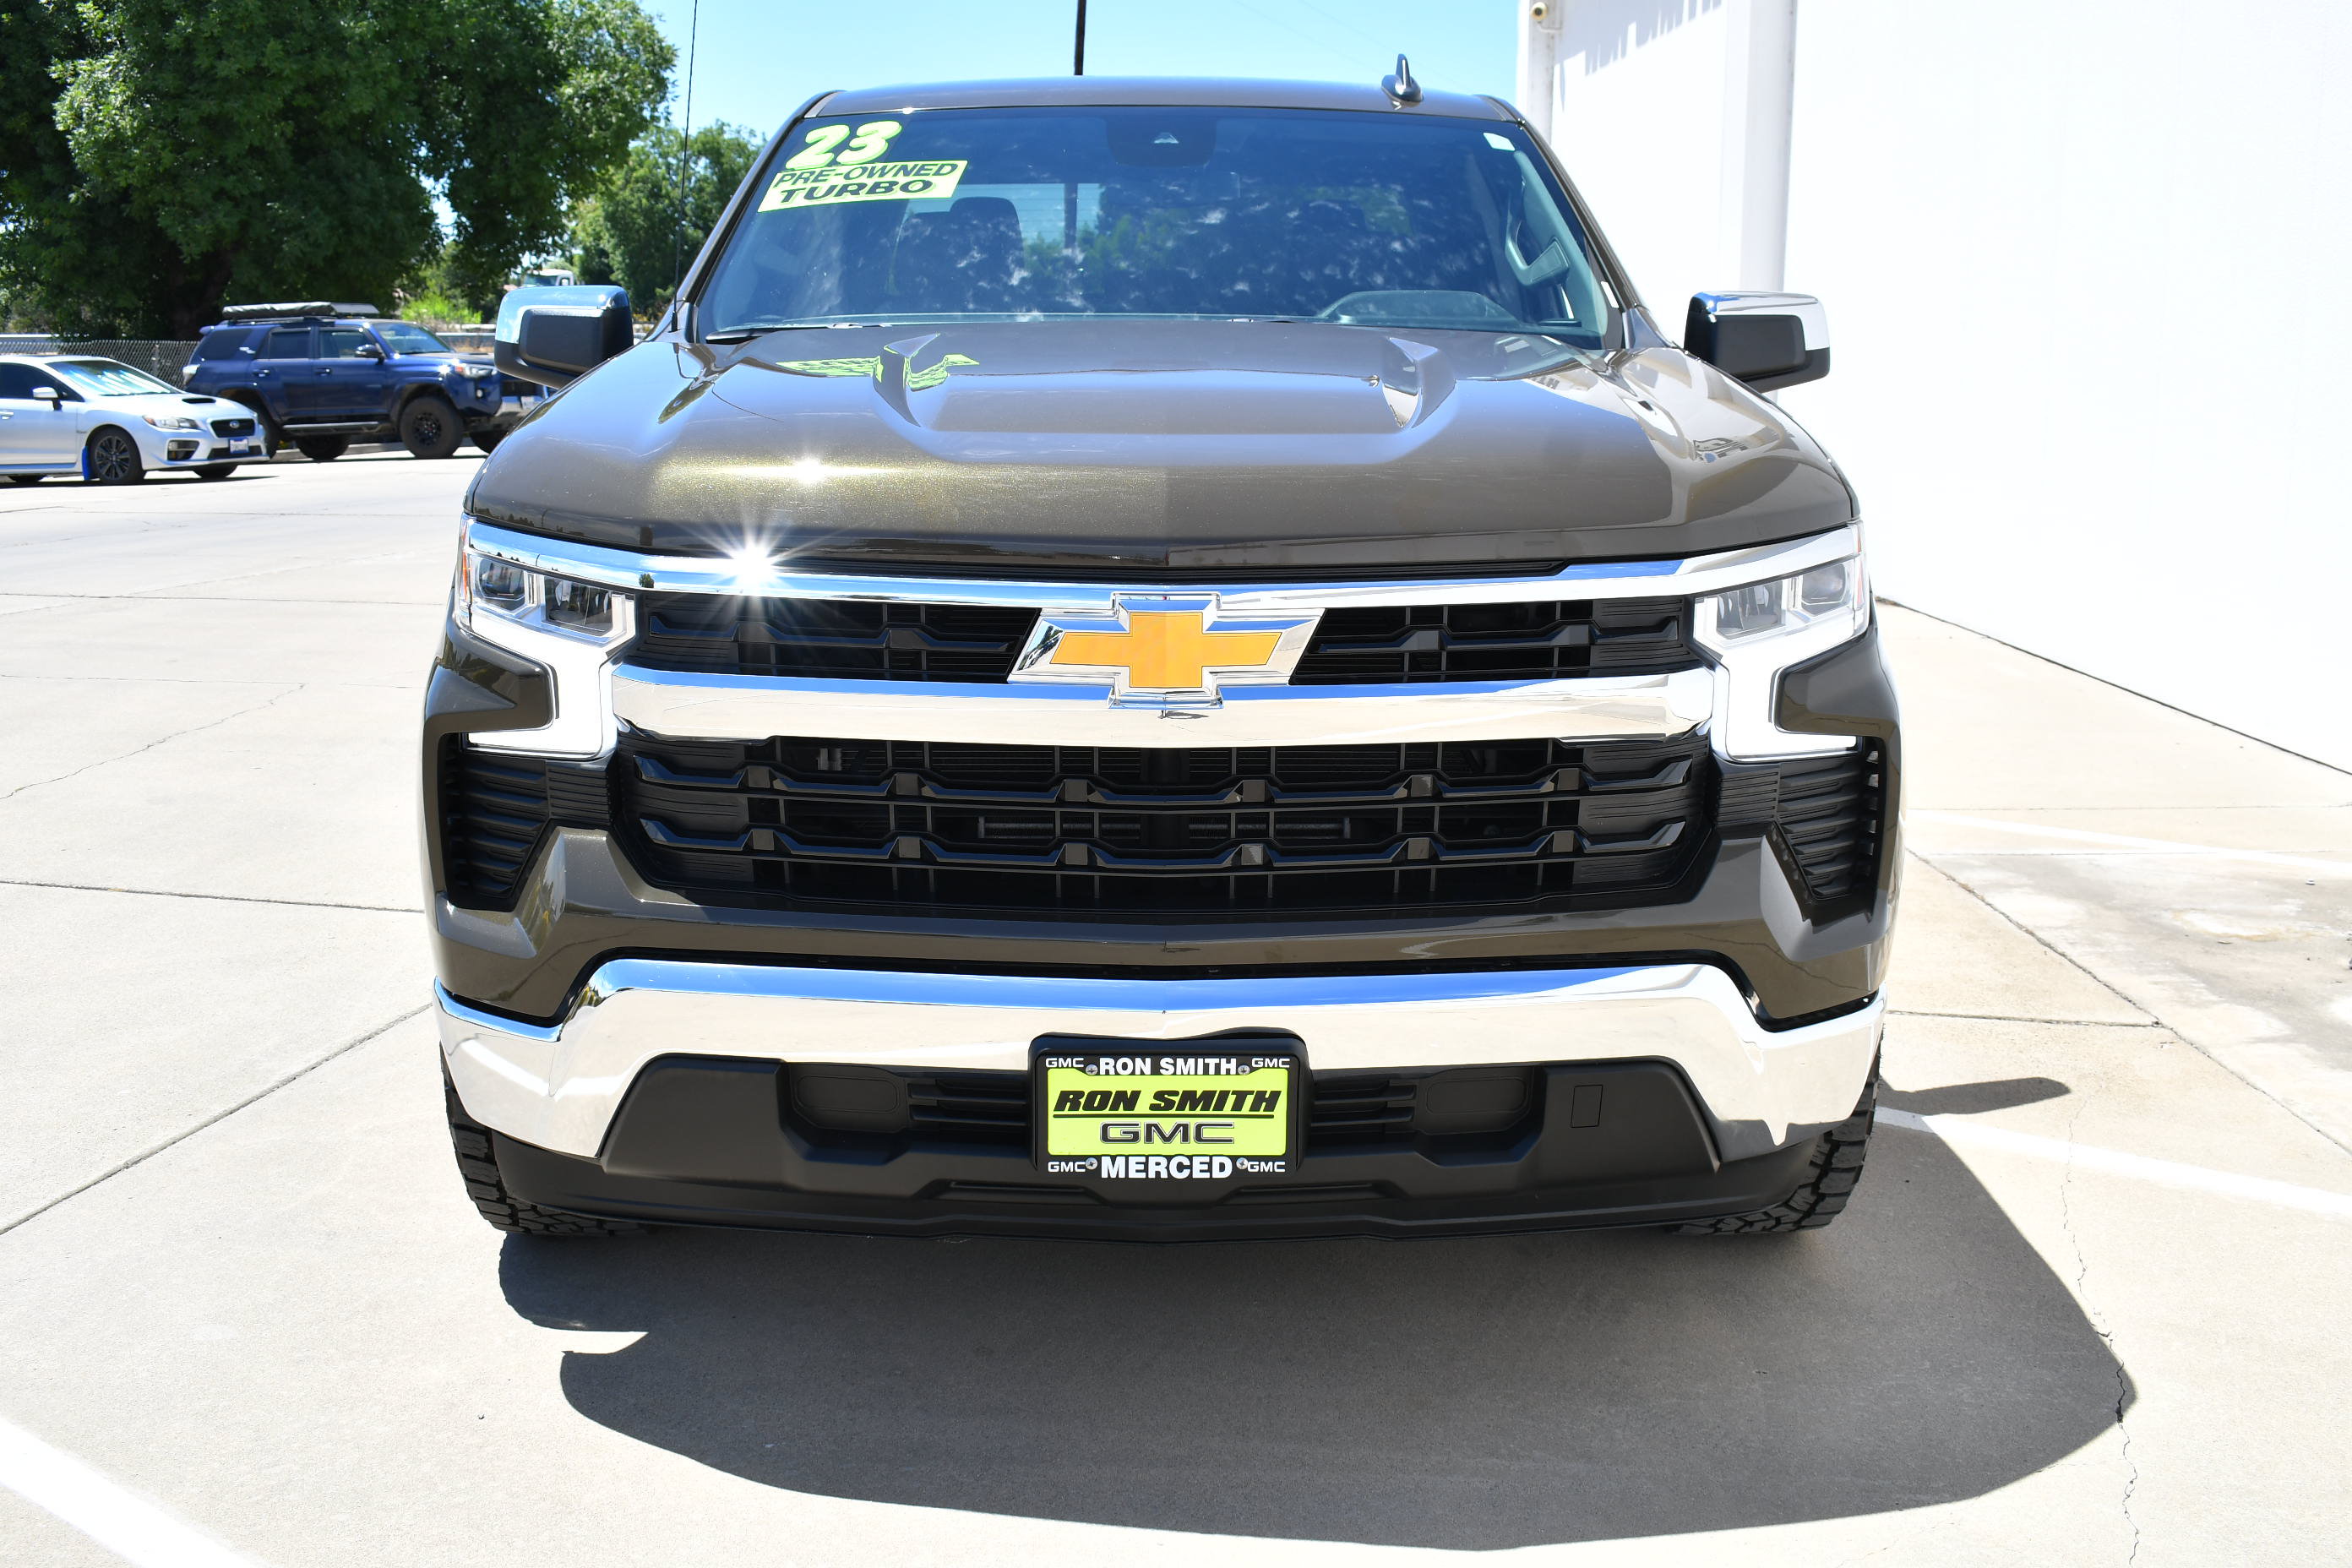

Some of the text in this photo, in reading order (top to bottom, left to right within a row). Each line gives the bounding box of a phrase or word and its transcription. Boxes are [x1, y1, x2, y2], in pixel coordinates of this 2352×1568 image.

[785, 120, 902, 171] 23
[772, 163, 959, 188] PRE-OWNED
[780, 179, 936, 204] TURBO
[1045, 1057, 1085, 1069] GMC
[1099, 1057, 1237, 1075] RON SMITH
[1251, 1058, 1290, 1069] GMC
[1054, 1090, 1282, 1113] RON SMITH
[1099, 1121, 1235, 1144] GMC
[1048, 1161, 1086, 1173] GMC
[1101, 1156, 1233, 1179] MERCED
[1247, 1161, 1286, 1173] GMC
